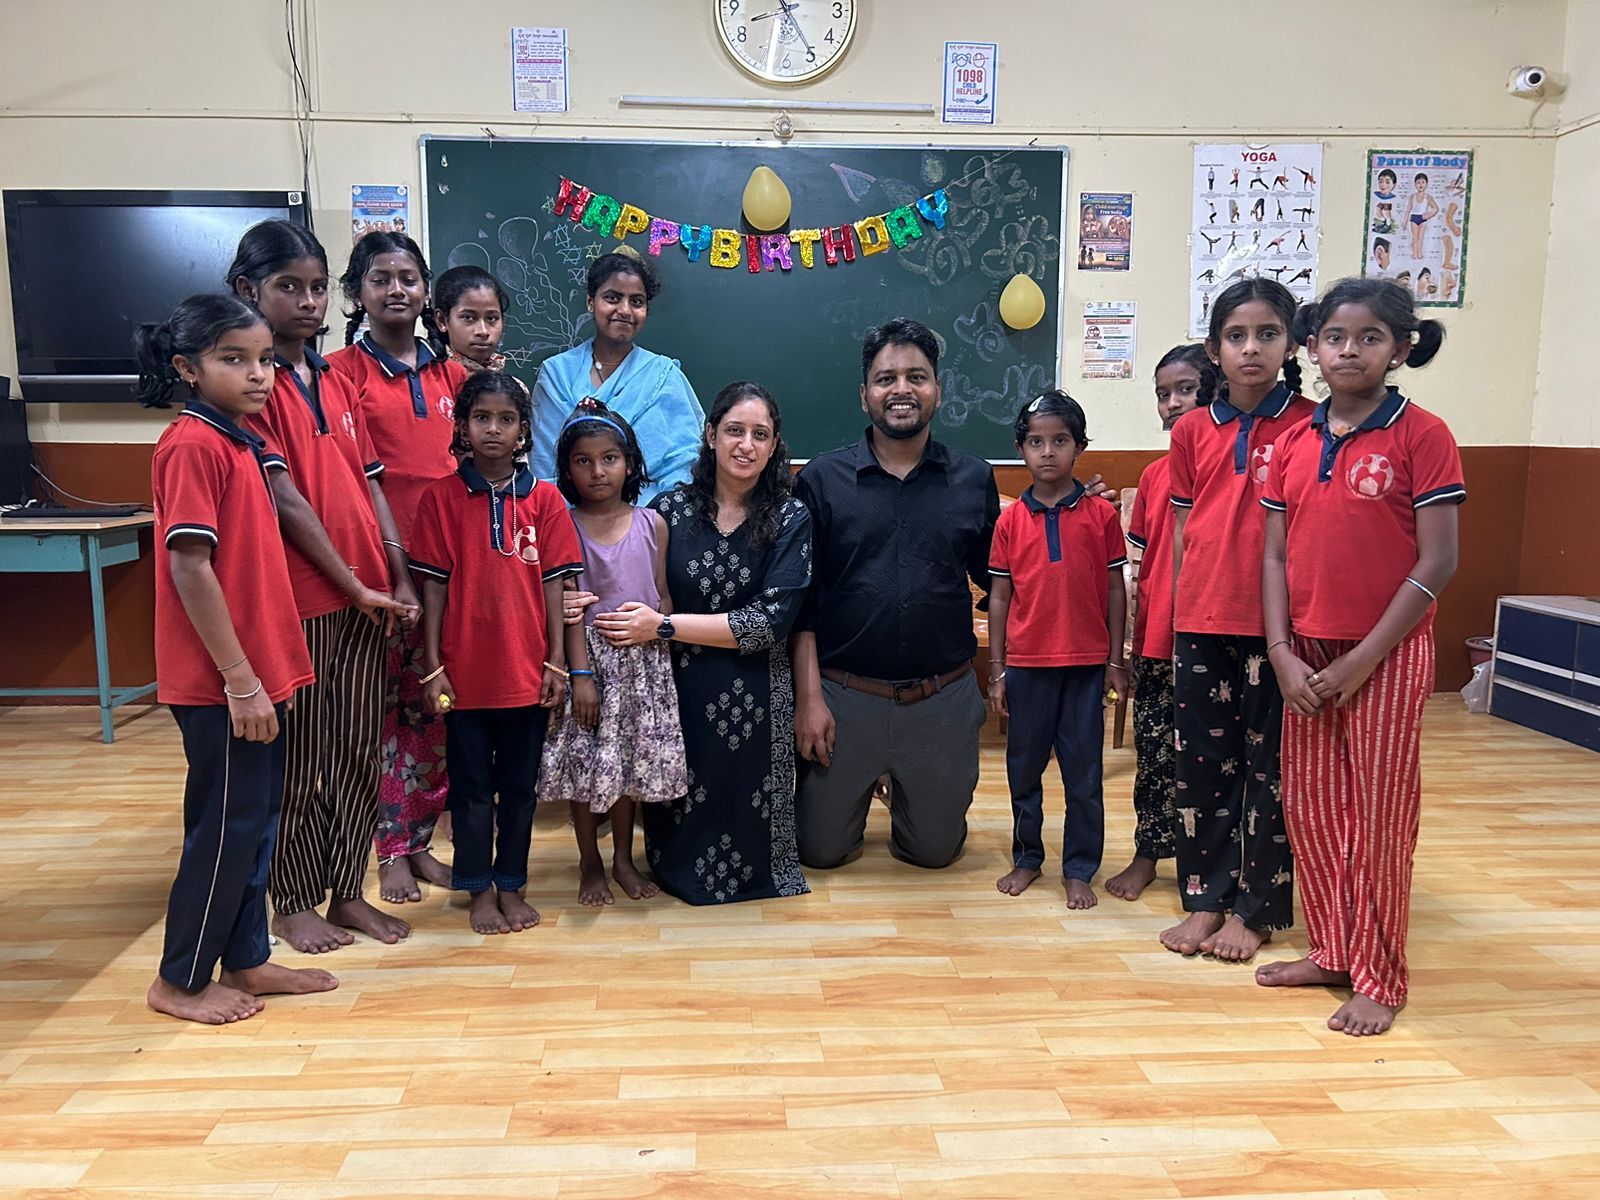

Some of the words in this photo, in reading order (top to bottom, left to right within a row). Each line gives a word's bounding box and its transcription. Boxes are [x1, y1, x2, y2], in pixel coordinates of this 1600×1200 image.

[729, 0, 739, 16] 9
[832, 2, 843, 19] 3
[737, 26, 747, 43] 8
[824, 27, 834, 44] 4
[782, 52, 791, 69] 6
[805, 46, 816, 63] 5
[957, 69, 983, 83] 1098
[1241, 152, 1277, 162] YOGA
[1376, 156, 1413, 166] Parts
[1415, 156, 1431, 166] of
[1432, 156, 1467, 169] Body
[553, 177, 713, 262] HAPPY
[709, 188, 949, 273] BIRTHDAY
